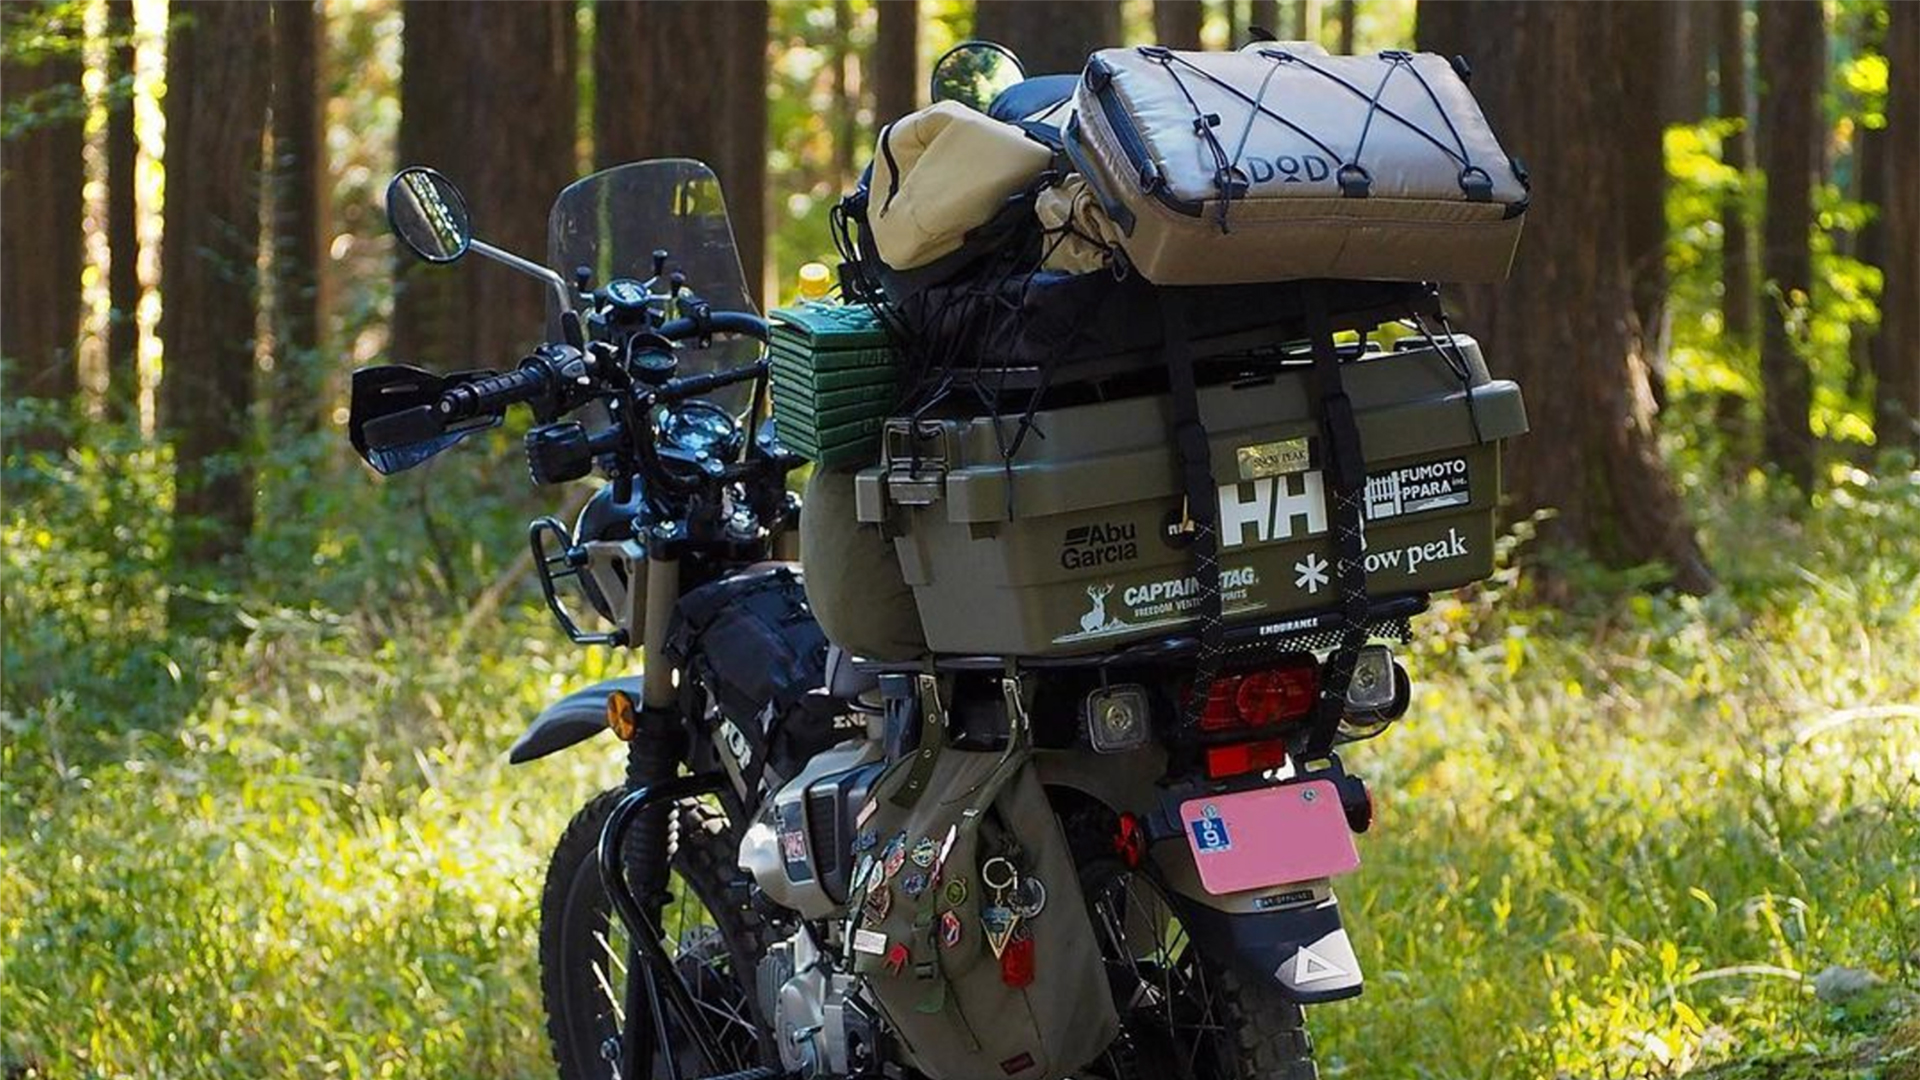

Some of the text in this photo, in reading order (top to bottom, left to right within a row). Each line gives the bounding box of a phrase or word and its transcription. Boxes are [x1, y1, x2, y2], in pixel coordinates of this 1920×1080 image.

[1246, 155, 1330, 183] DOD
[1400, 459, 1466, 483] FUMOTO
[1402, 480, 1451, 500] PPARA
[1218, 470, 1328, 547] HH
[1089, 521, 1136, 547] Abu
[1061, 545, 1138, 571] Garcia
[1407, 527, 1468, 574] peak
[1259, 617, 1318, 635] ENDURANCE
